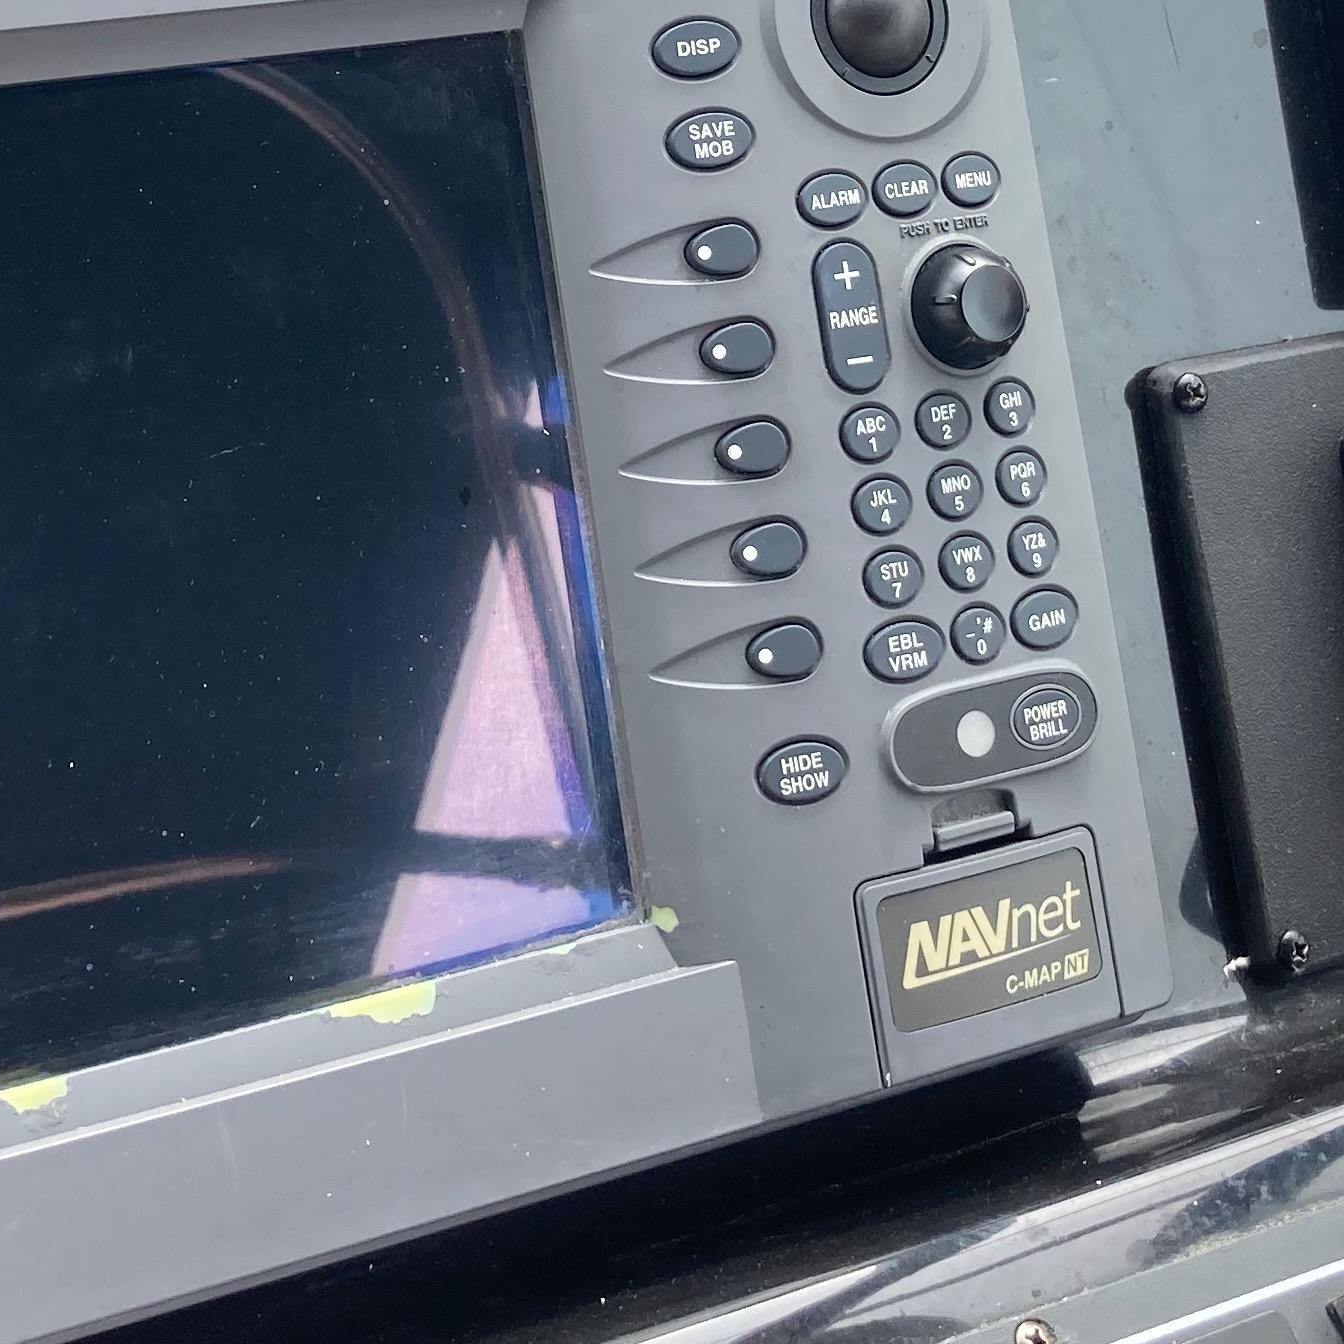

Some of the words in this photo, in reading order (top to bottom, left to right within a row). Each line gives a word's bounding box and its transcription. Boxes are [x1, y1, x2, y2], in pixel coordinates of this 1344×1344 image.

[676, 38, 721, 57] DISP
[688, 120, 735, 140] SAVE
[694, 140, 734, 159] MOB
[884, 179, 928, 199] CLEAR
[955, 170, 991, 189] MENU
[811, 188, 860, 211] ALARM
[899, 221, 931, 239] PUSH
[934, 218, 949, 233] TO
[953, 214, 989, 231] ENTER
[829, 305, 879, 330] RANGE
[999, 391, 1022, 408] GHI
[931, 404, 956, 421] DEF
[1009, 411, 1018, 427] 3
[856, 416, 886, 436] ABC
[942, 424, 952, 440] 2
[868, 437, 877, 453] 1
[1009, 461, 1035, 480] PQR
[941, 475, 971, 495] MNO
[1021, 481, 1030, 497] 6
[869, 488, 897, 507] JKL
[954, 495, 964, 512] 5
[880, 508, 891, 525] 4
[1022, 532, 1046, 551] YZ&
[952, 546, 983, 565] VWX
[1032, 552, 1042, 568] 9
[880, 561, 908, 580] STU
[966, 566, 975, 583] 8
[892, 582, 902, 598] 7
[1028, 609, 1065, 632] GAIN
[888, 631, 924, 653] EBL
[977, 639, 987, 655] 0
[888, 654, 928, 673] VRM
[1023, 699, 1067, 724] POWER
[1029, 718, 1068, 741] BRILL
[781, 751, 824, 774] HIDE
[780, 770, 829, 796] SHOW
[902, 880, 1081, 990] NAVnet
[1006, 960, 1061, 994] C-MAP
